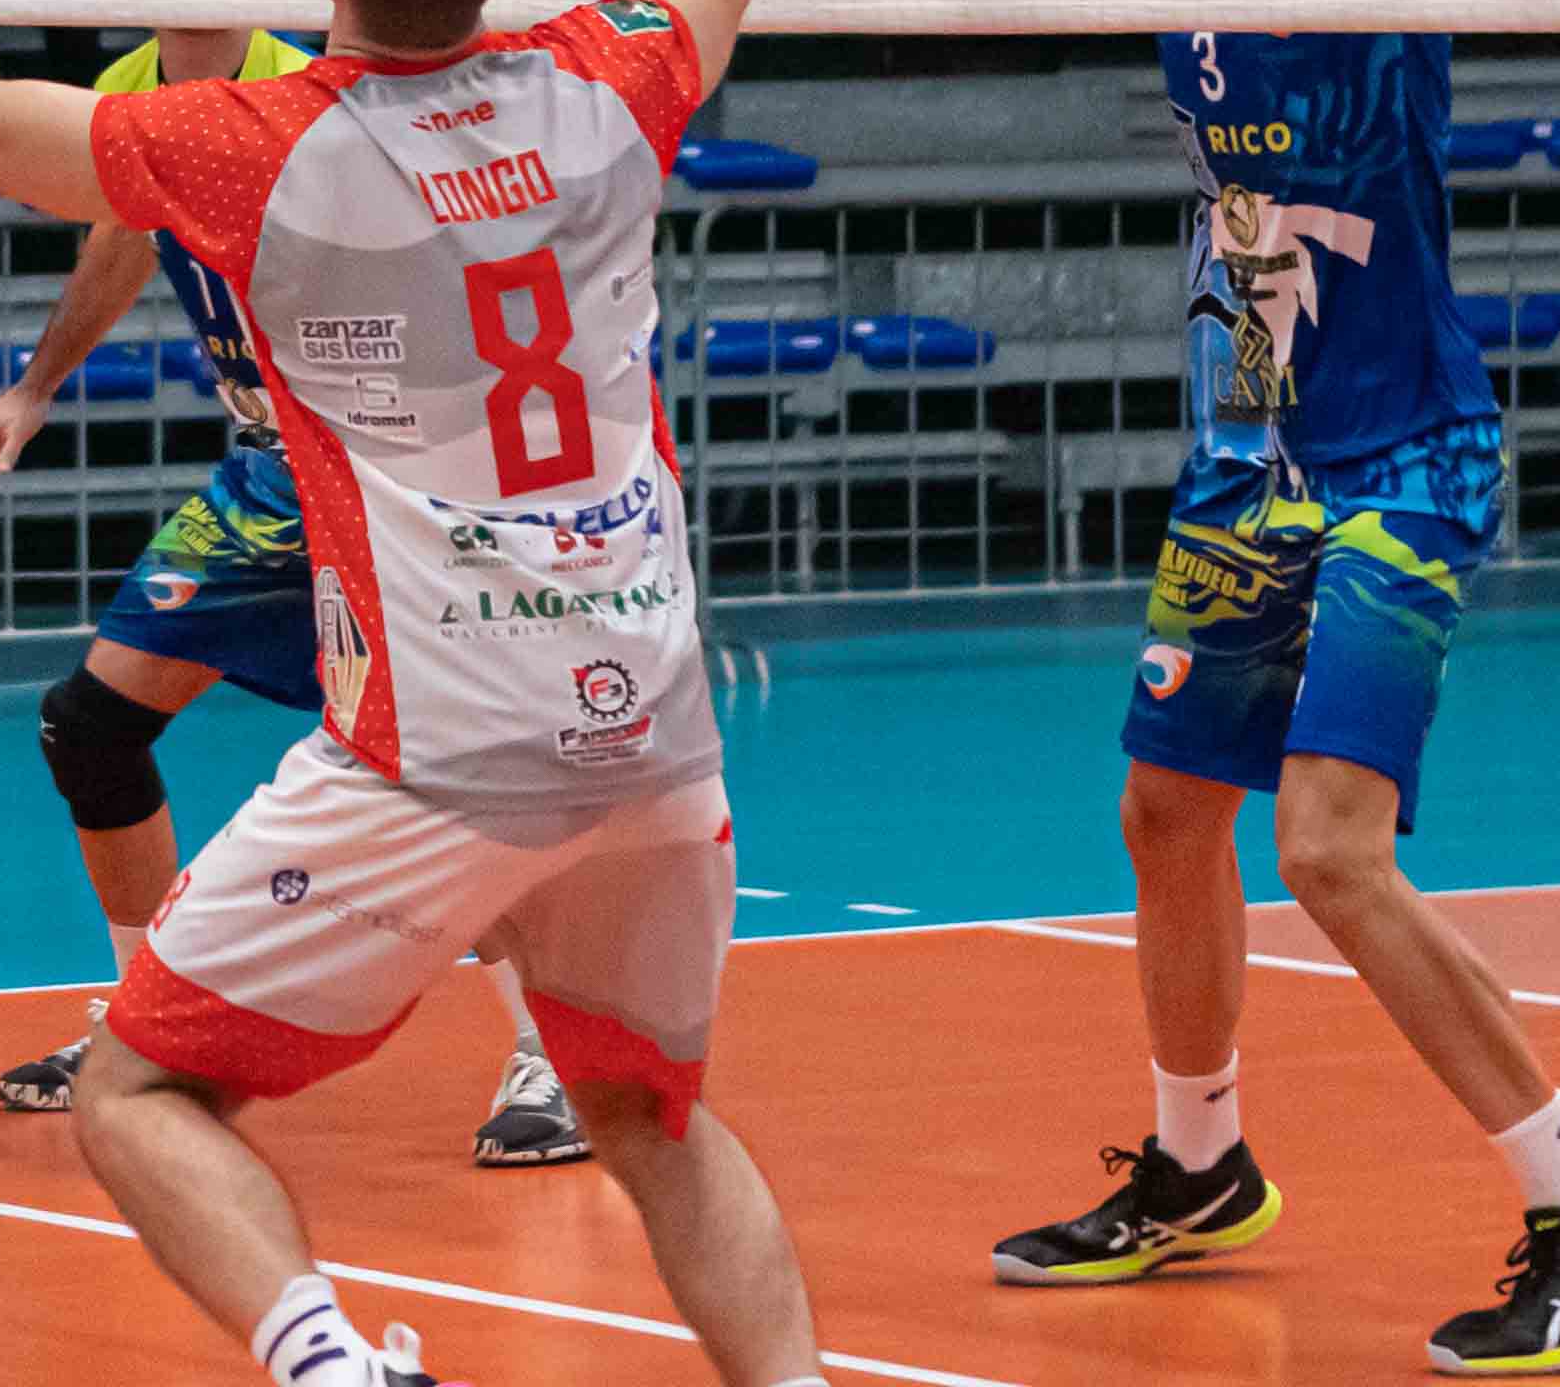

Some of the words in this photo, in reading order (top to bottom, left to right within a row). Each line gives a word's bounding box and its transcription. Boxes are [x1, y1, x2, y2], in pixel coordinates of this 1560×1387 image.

[1191, 31, 1226, 102] 3
[1206, 121, 1292, 155] RICO
[415, 148, 559, 225] LONGO
[300, 318, 398, 340] zanzar
[207, 335, 257, 360] RIC
[304, 339, 401, 360] sistem
[462, 244, 597, 499] 8
